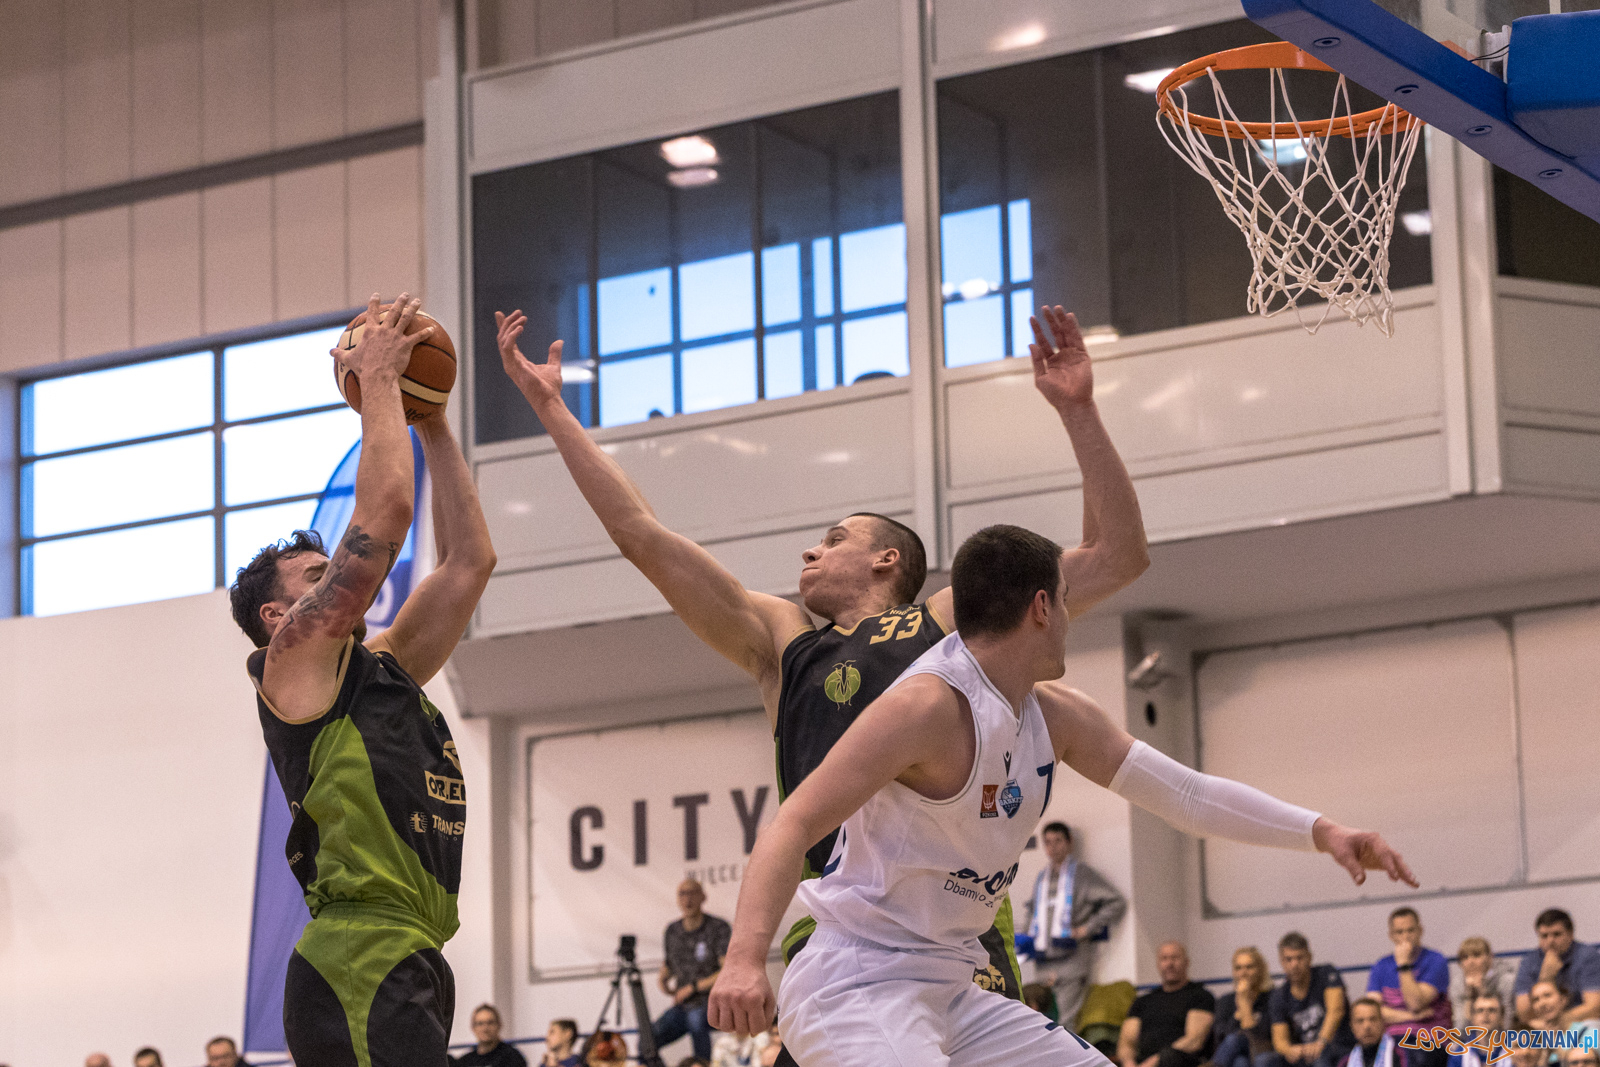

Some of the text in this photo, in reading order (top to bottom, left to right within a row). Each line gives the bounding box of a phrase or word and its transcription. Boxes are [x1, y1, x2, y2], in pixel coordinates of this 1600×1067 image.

[869, 611, 922, 645] 33
[569, 785, 770, 873] CITY
[943, 879, 980, 902] Dbamy
